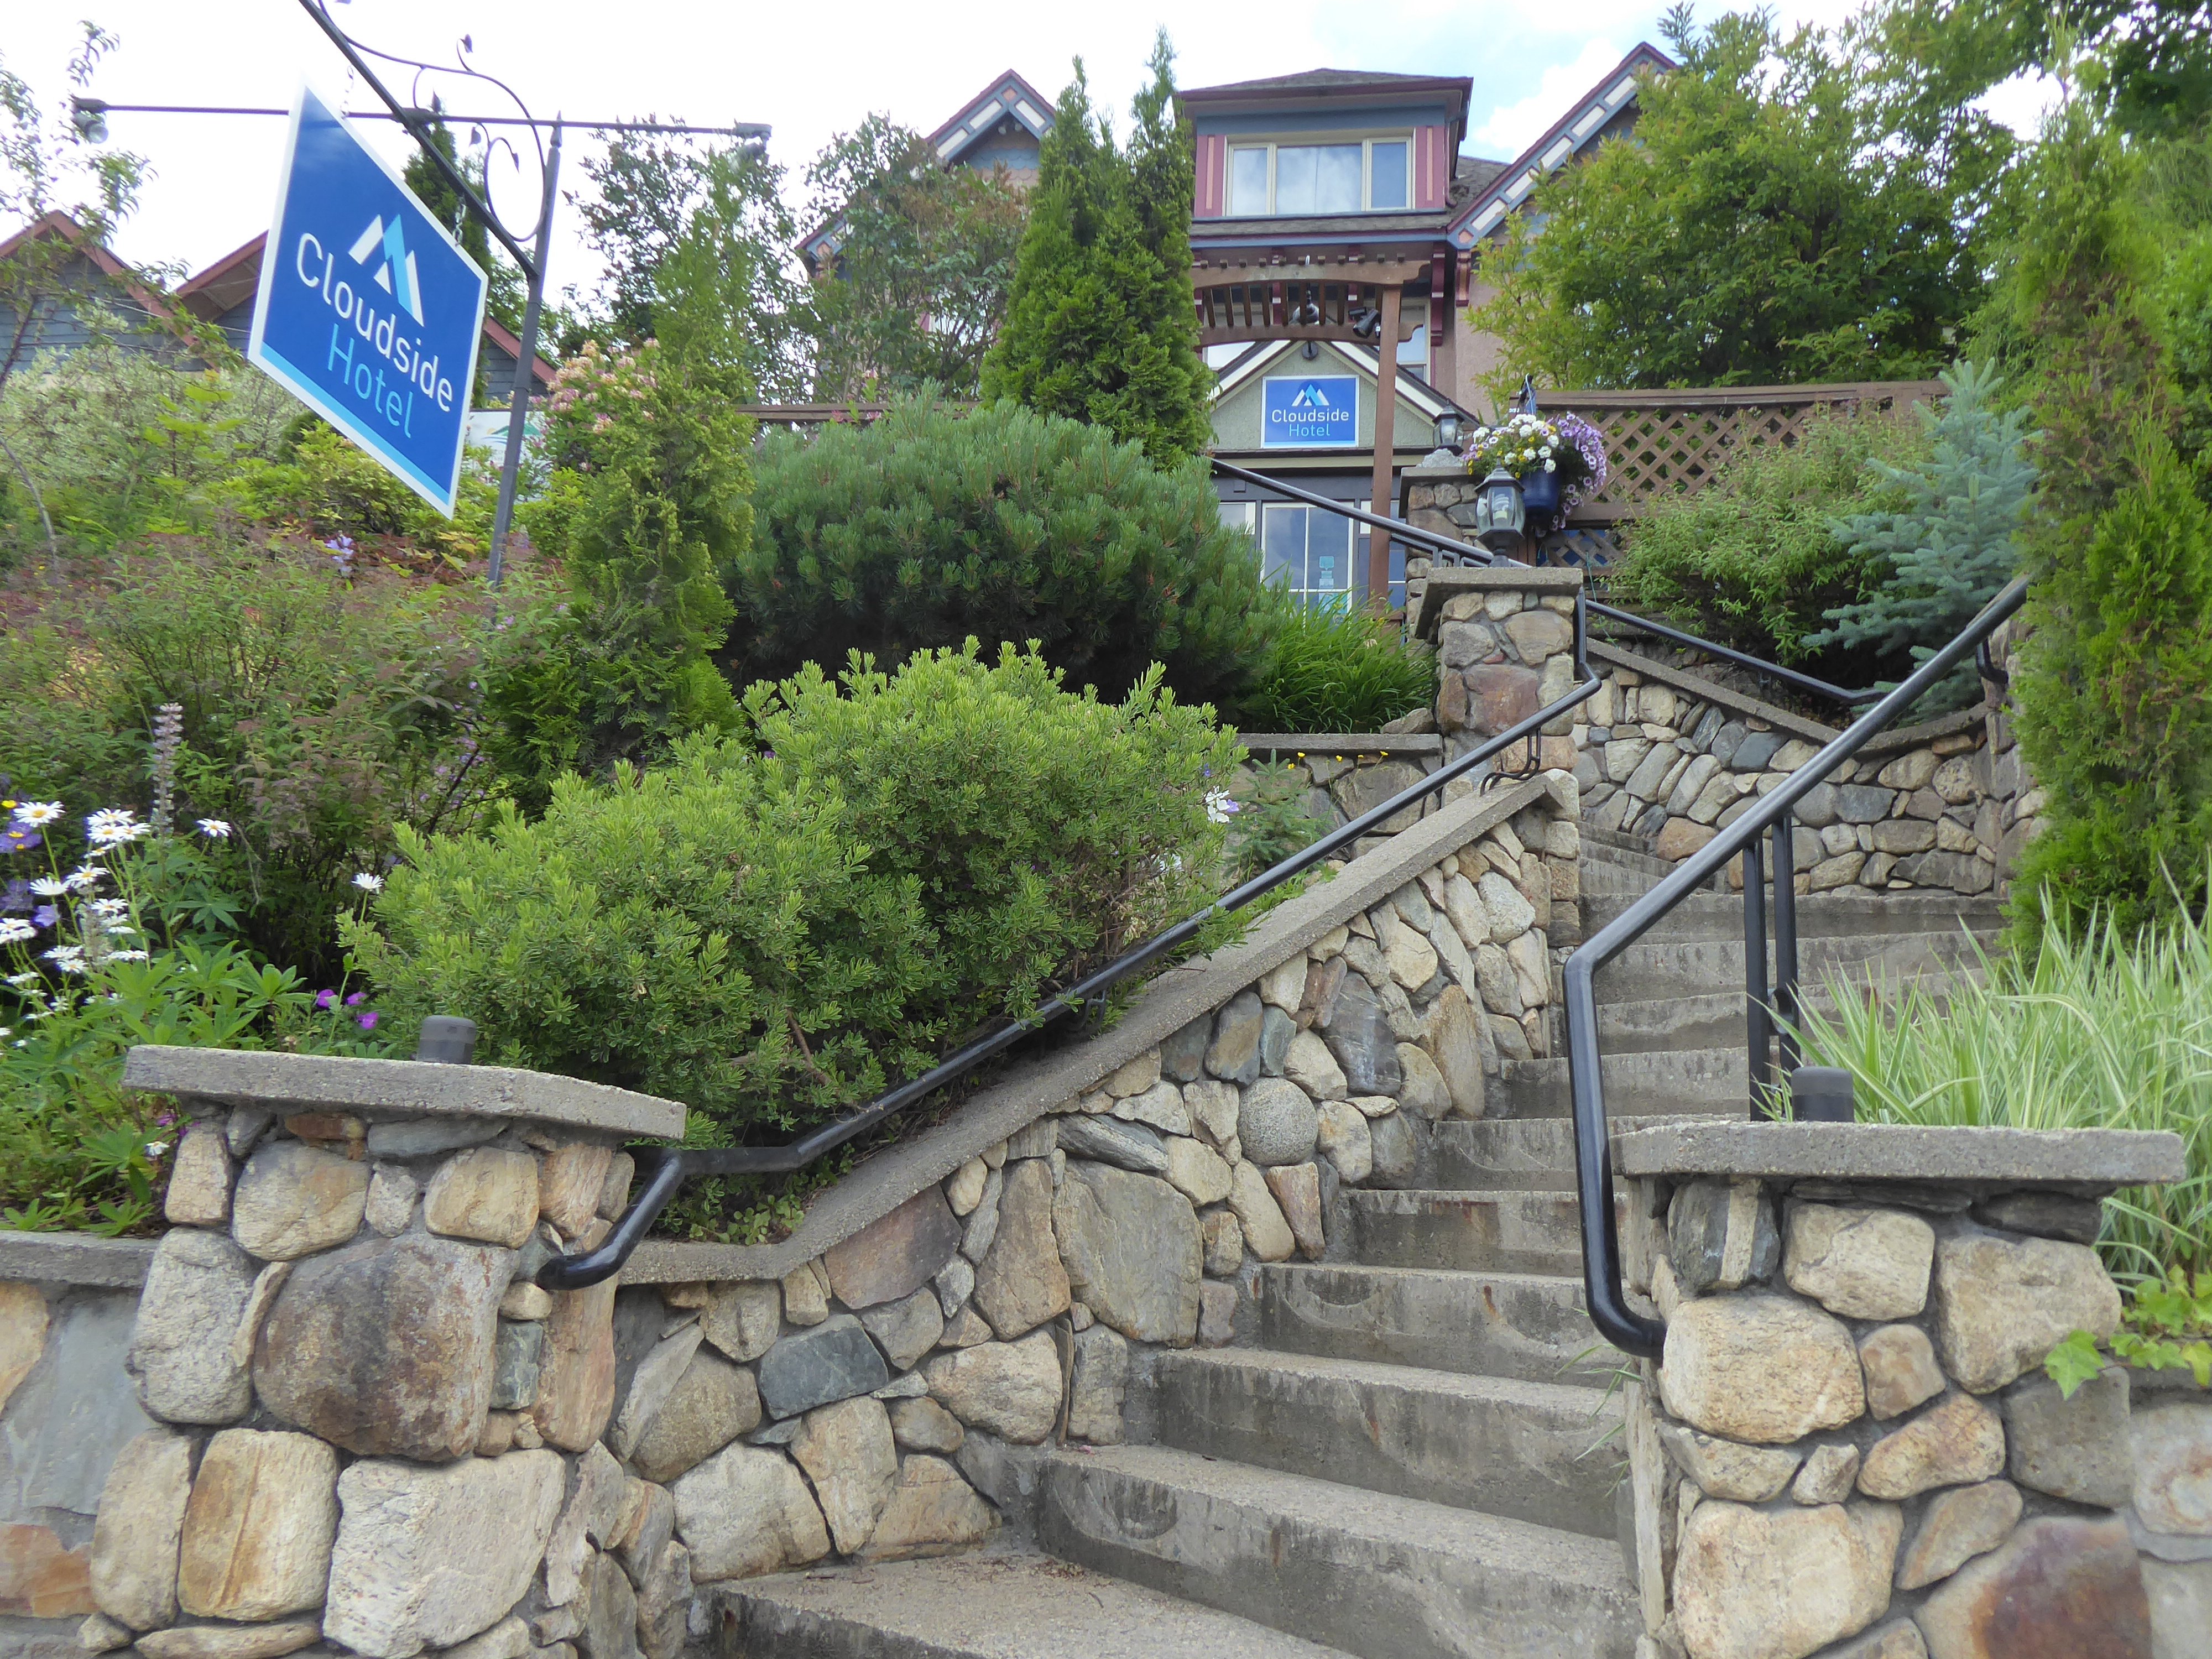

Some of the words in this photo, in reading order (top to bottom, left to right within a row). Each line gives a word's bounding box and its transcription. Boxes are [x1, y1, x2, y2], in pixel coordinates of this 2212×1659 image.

[297, 233, 453, 412] Cloudside
[328, 323, 413, 438] Hotel
[1272, 408, 1349, 422] Cloudside
[1289, 424, 1330, 436] Hotel
